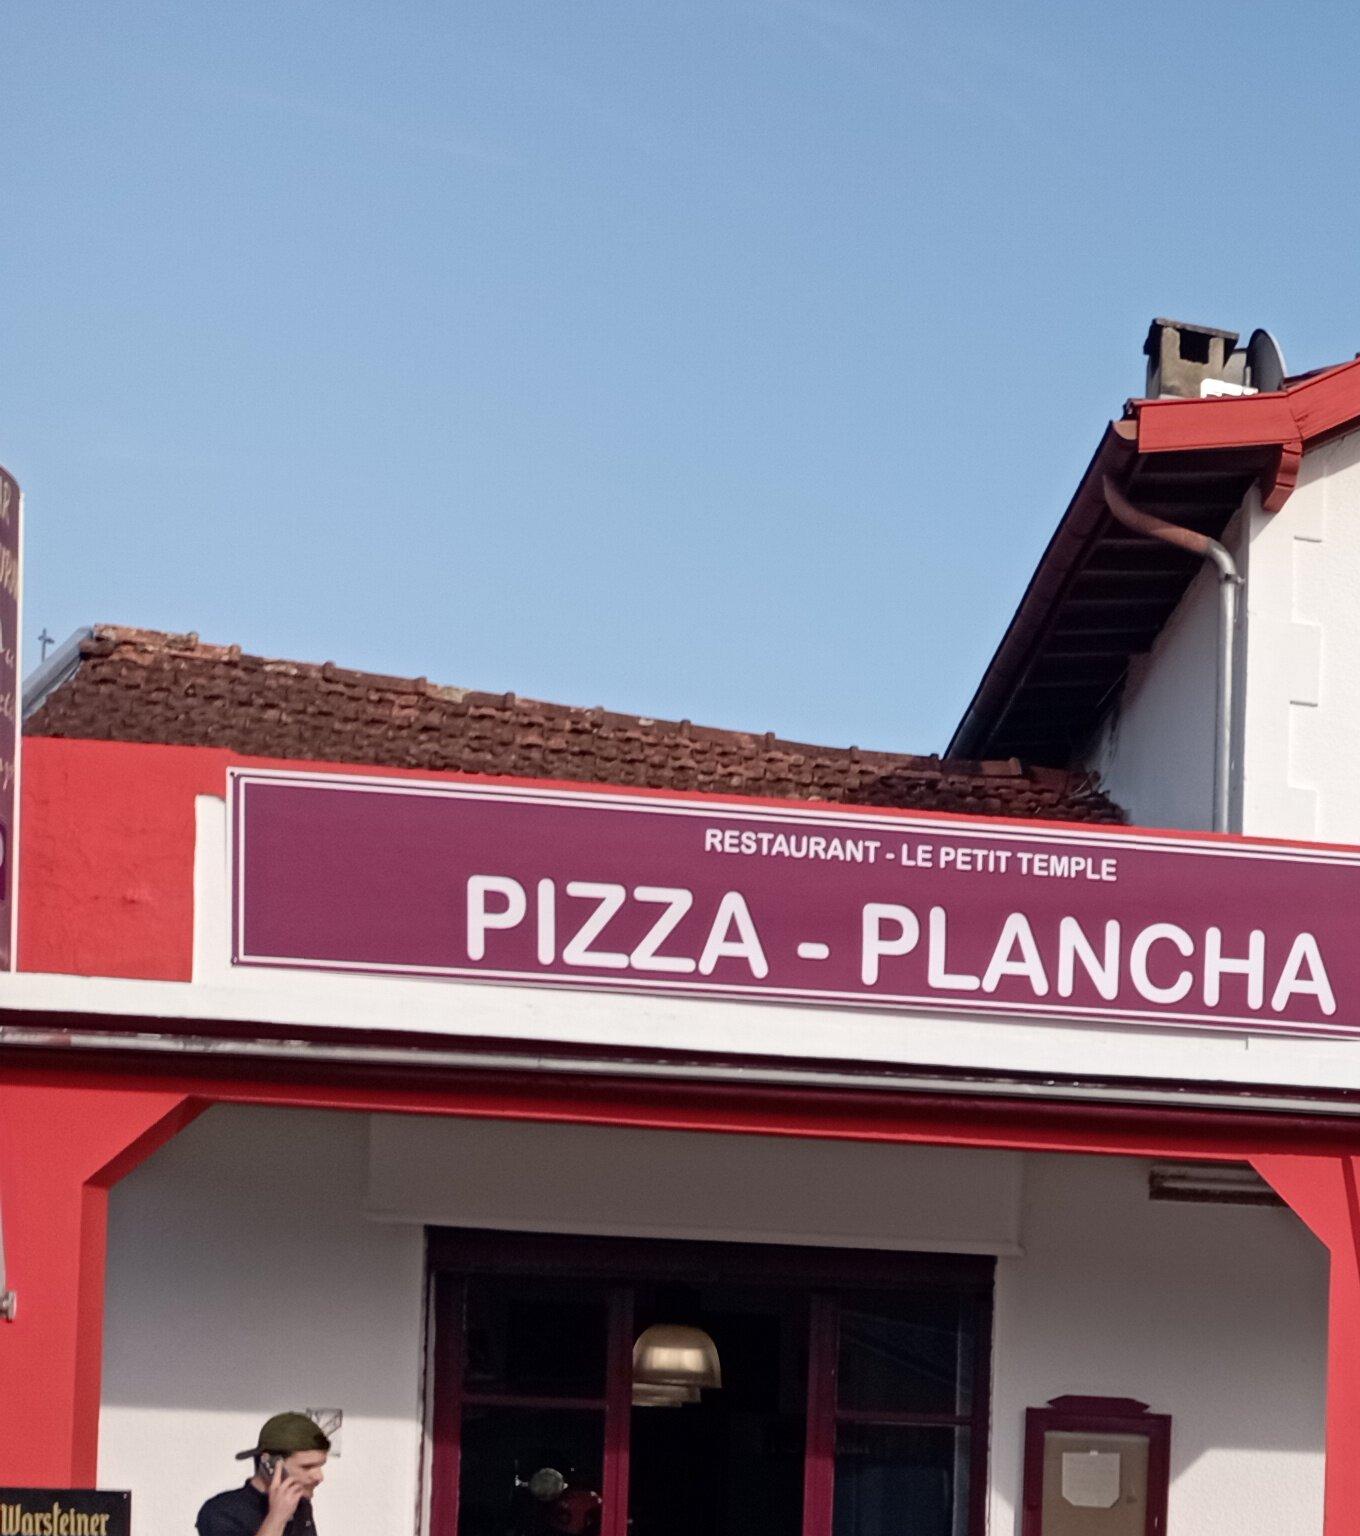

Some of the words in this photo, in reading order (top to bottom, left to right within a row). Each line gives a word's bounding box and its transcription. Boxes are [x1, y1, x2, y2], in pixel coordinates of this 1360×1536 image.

[704, 828, 882, 864] RESTAURANT
[901, 843, 934, 868] LE
[939, 846, 1012, 873] PETIT
[1016, 852, 1118, 882] TEMPLE
[466, 874, 769, 980] PIZZA
[861, 902, 1337, 1016] PLANCHA
